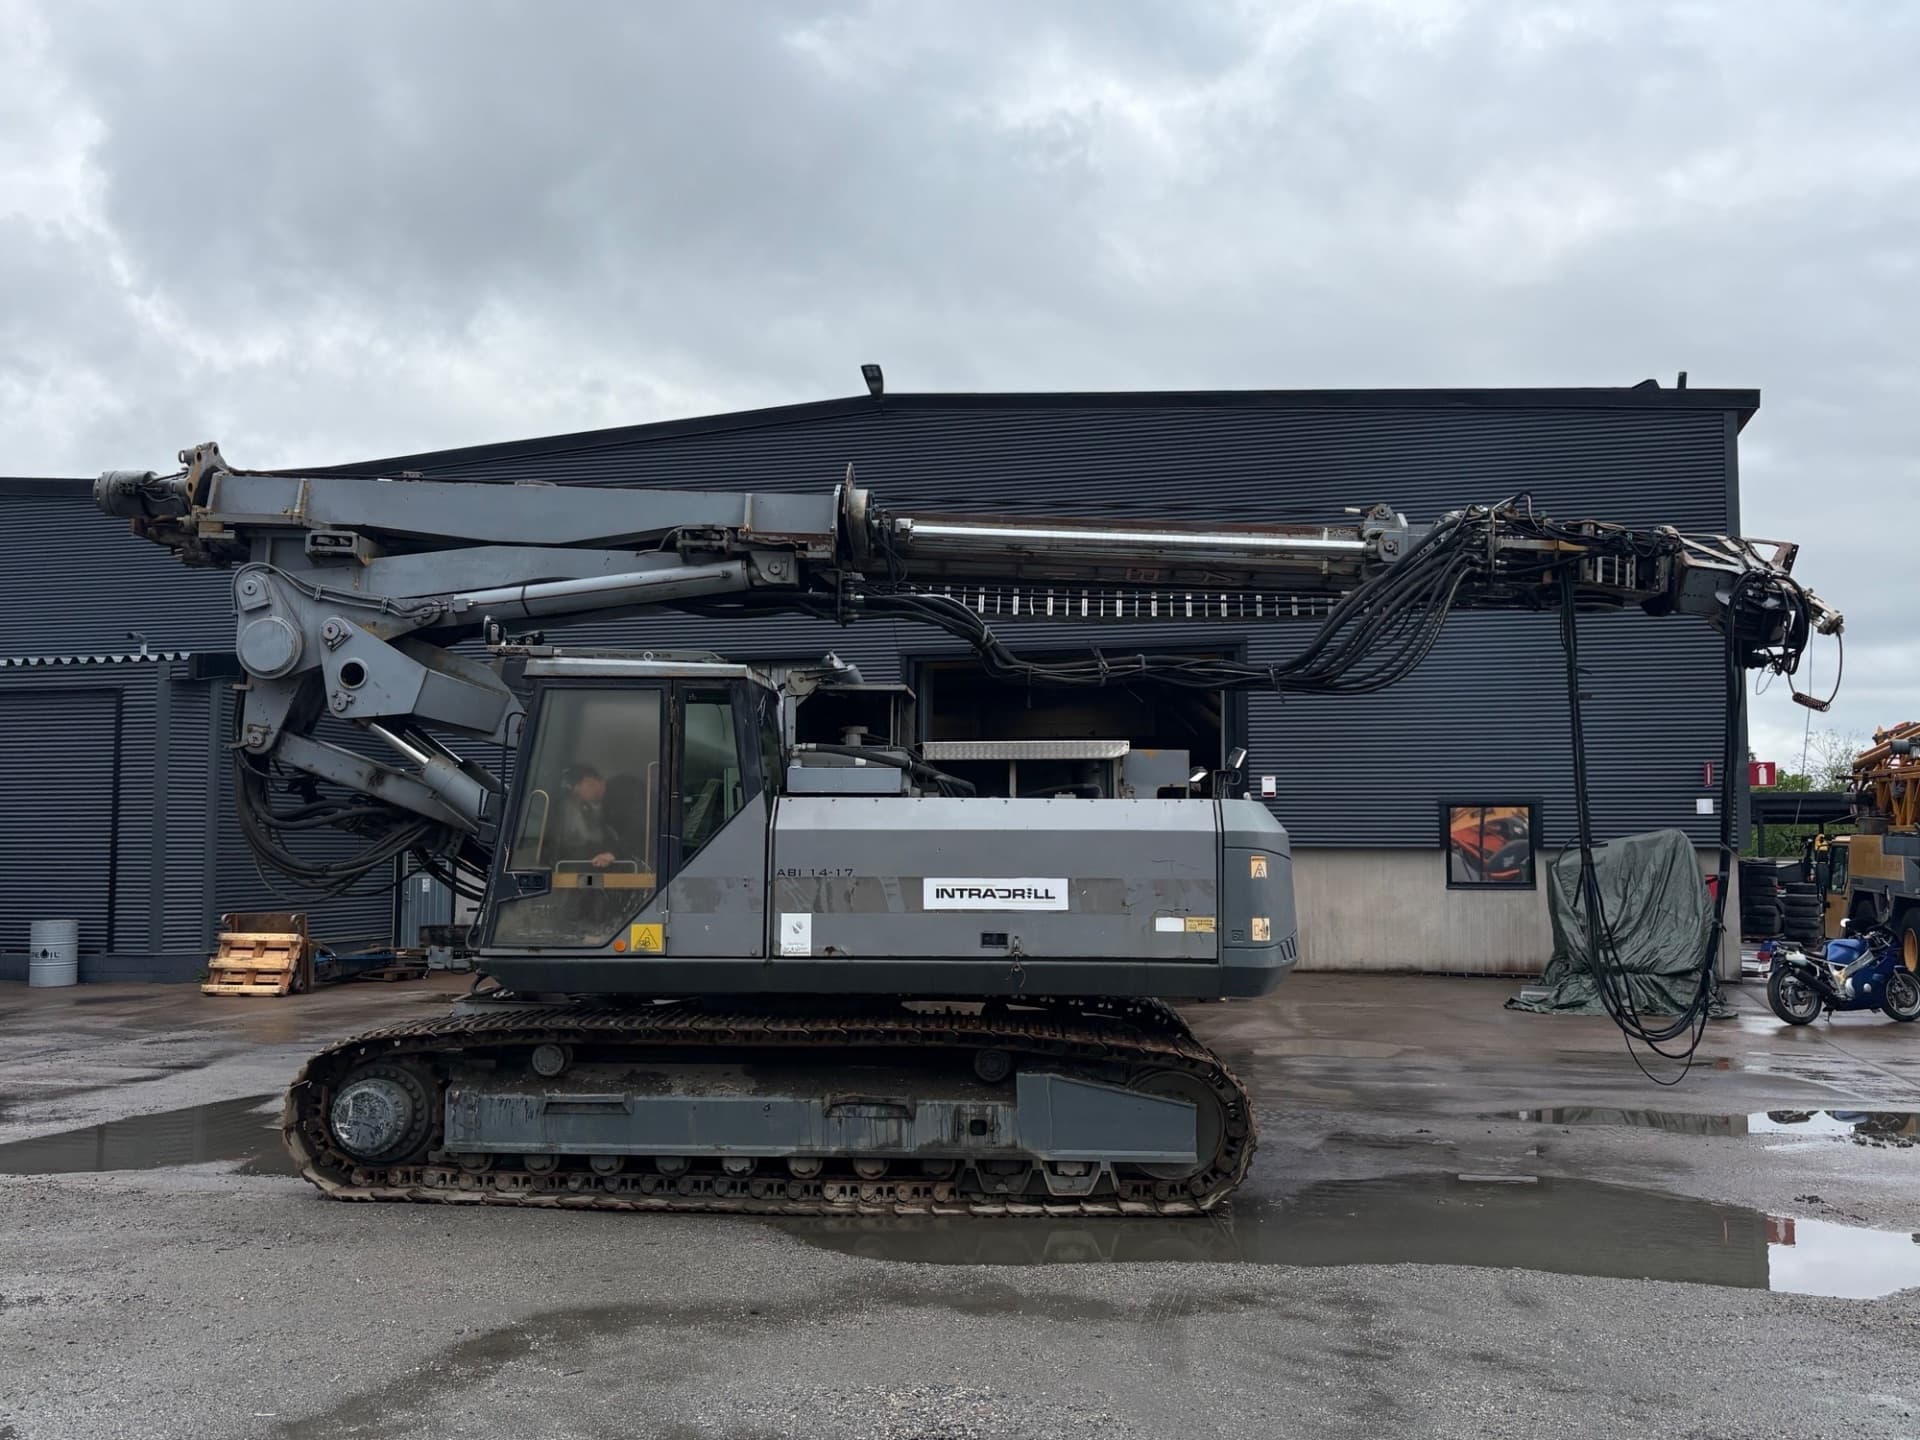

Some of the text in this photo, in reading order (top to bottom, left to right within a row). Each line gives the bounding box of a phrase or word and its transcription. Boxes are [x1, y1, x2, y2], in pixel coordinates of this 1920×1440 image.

[776, 868, 854, 877] ABI 14-17
[935, 887, 1056, 899] INTRADRILL
